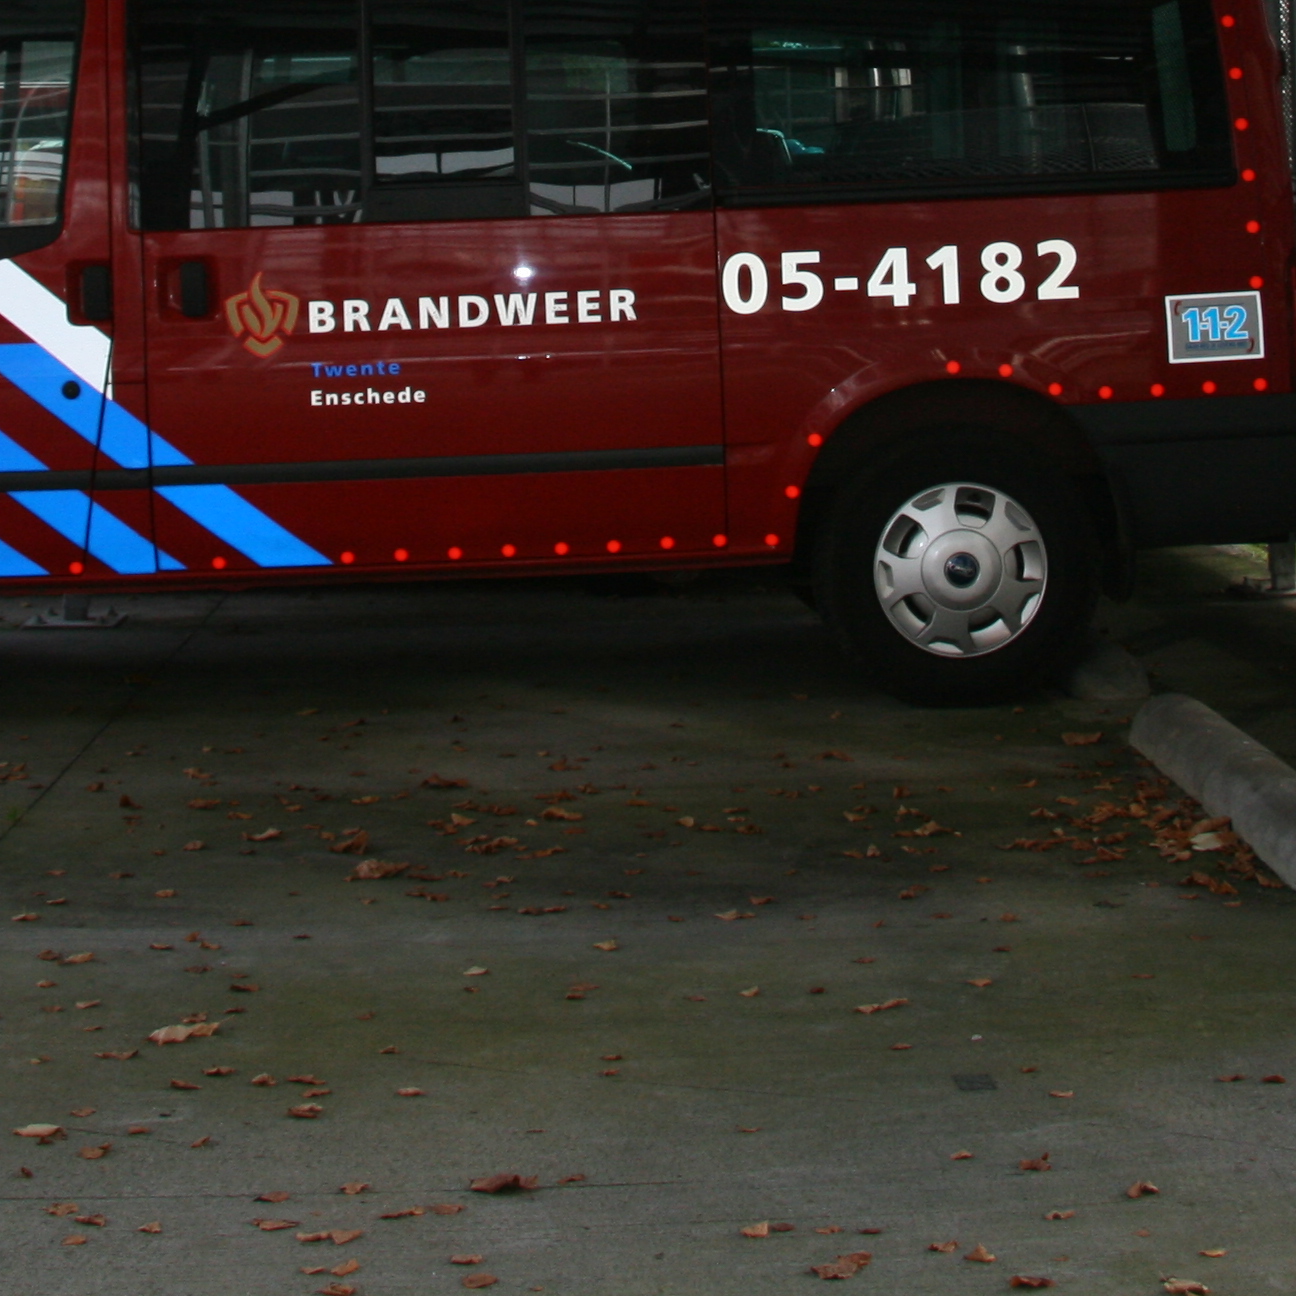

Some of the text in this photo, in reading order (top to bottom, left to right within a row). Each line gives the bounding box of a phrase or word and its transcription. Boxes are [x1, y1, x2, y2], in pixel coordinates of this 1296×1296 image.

[721, 238, 1080, 315] 05-4182
[307, 288, 638, 334] BRANDWEER
[310, 359, 401, 378] Twente
[310, 385, 427, 407] Enschede
